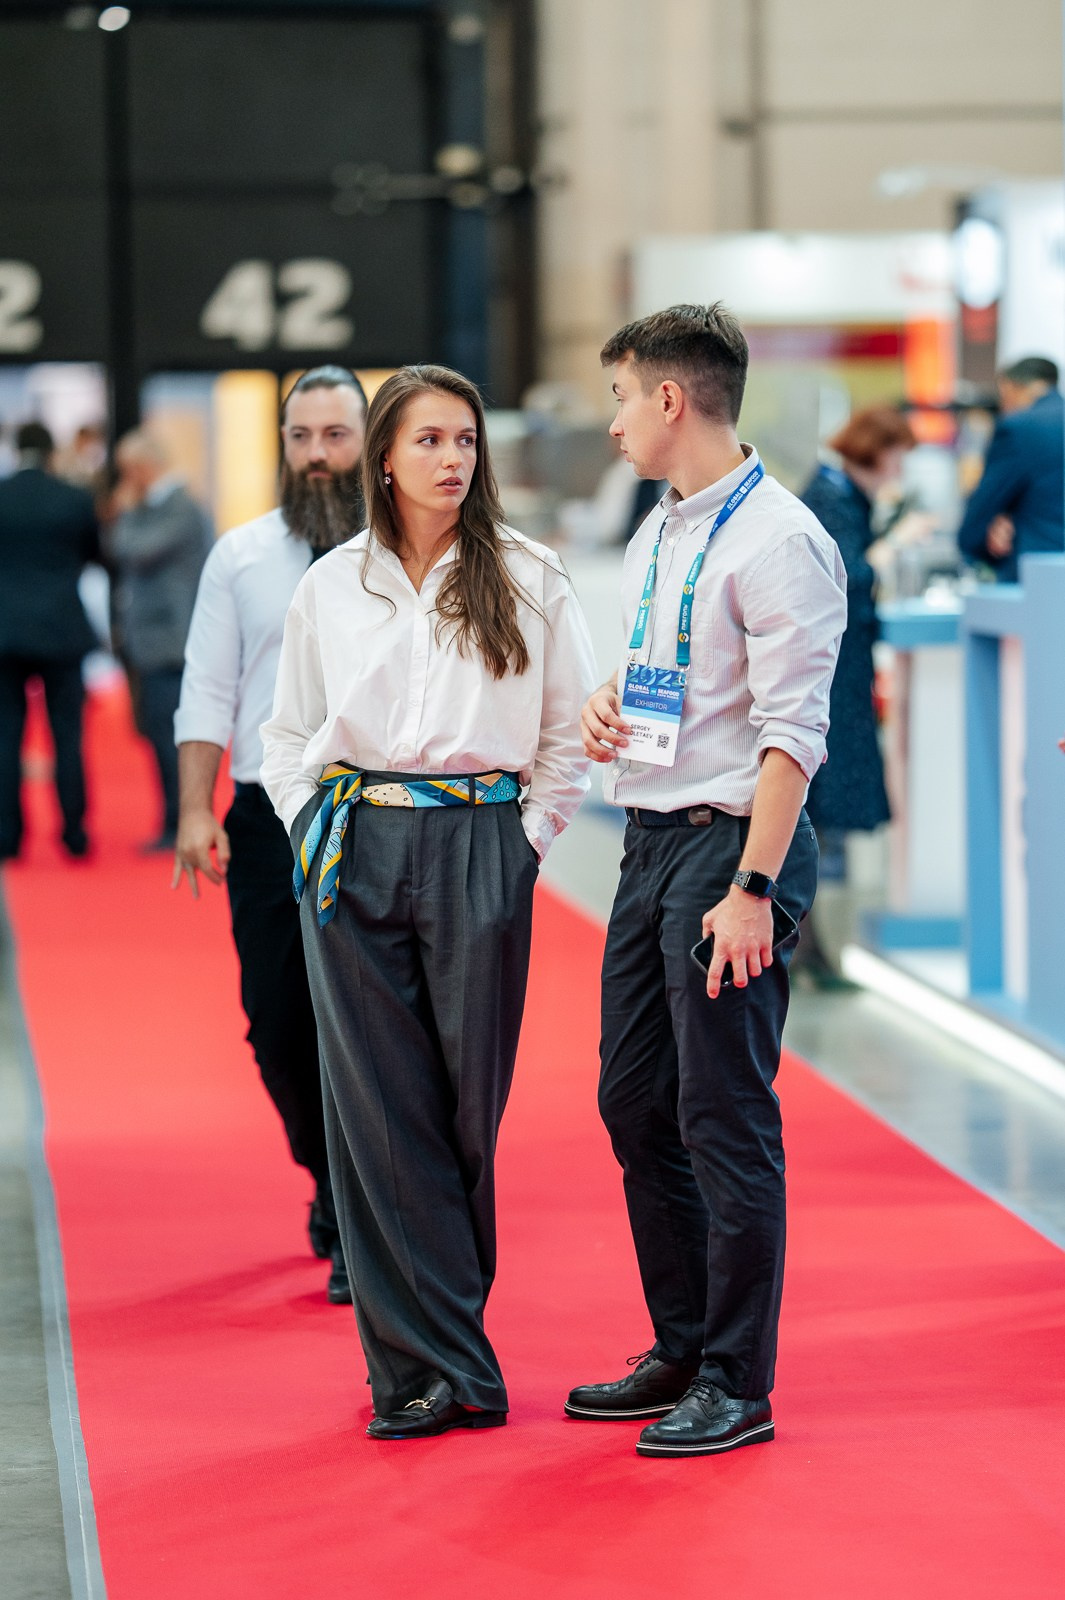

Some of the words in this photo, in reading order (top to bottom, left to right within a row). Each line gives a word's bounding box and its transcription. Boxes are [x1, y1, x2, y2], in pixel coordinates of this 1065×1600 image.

[200, 258, 353, 351] 42
[726, 491, 741, 509] GLOBAL
[743, 470, 759, 487] SEAFOOD
[627, 683, 650, 691] GLOBAL
[657, 688, 680, 697] SEAFOOD
[635, 699, 668, 710] EXHIBITOR
[630, 730, 653, 739] OLETAEV
